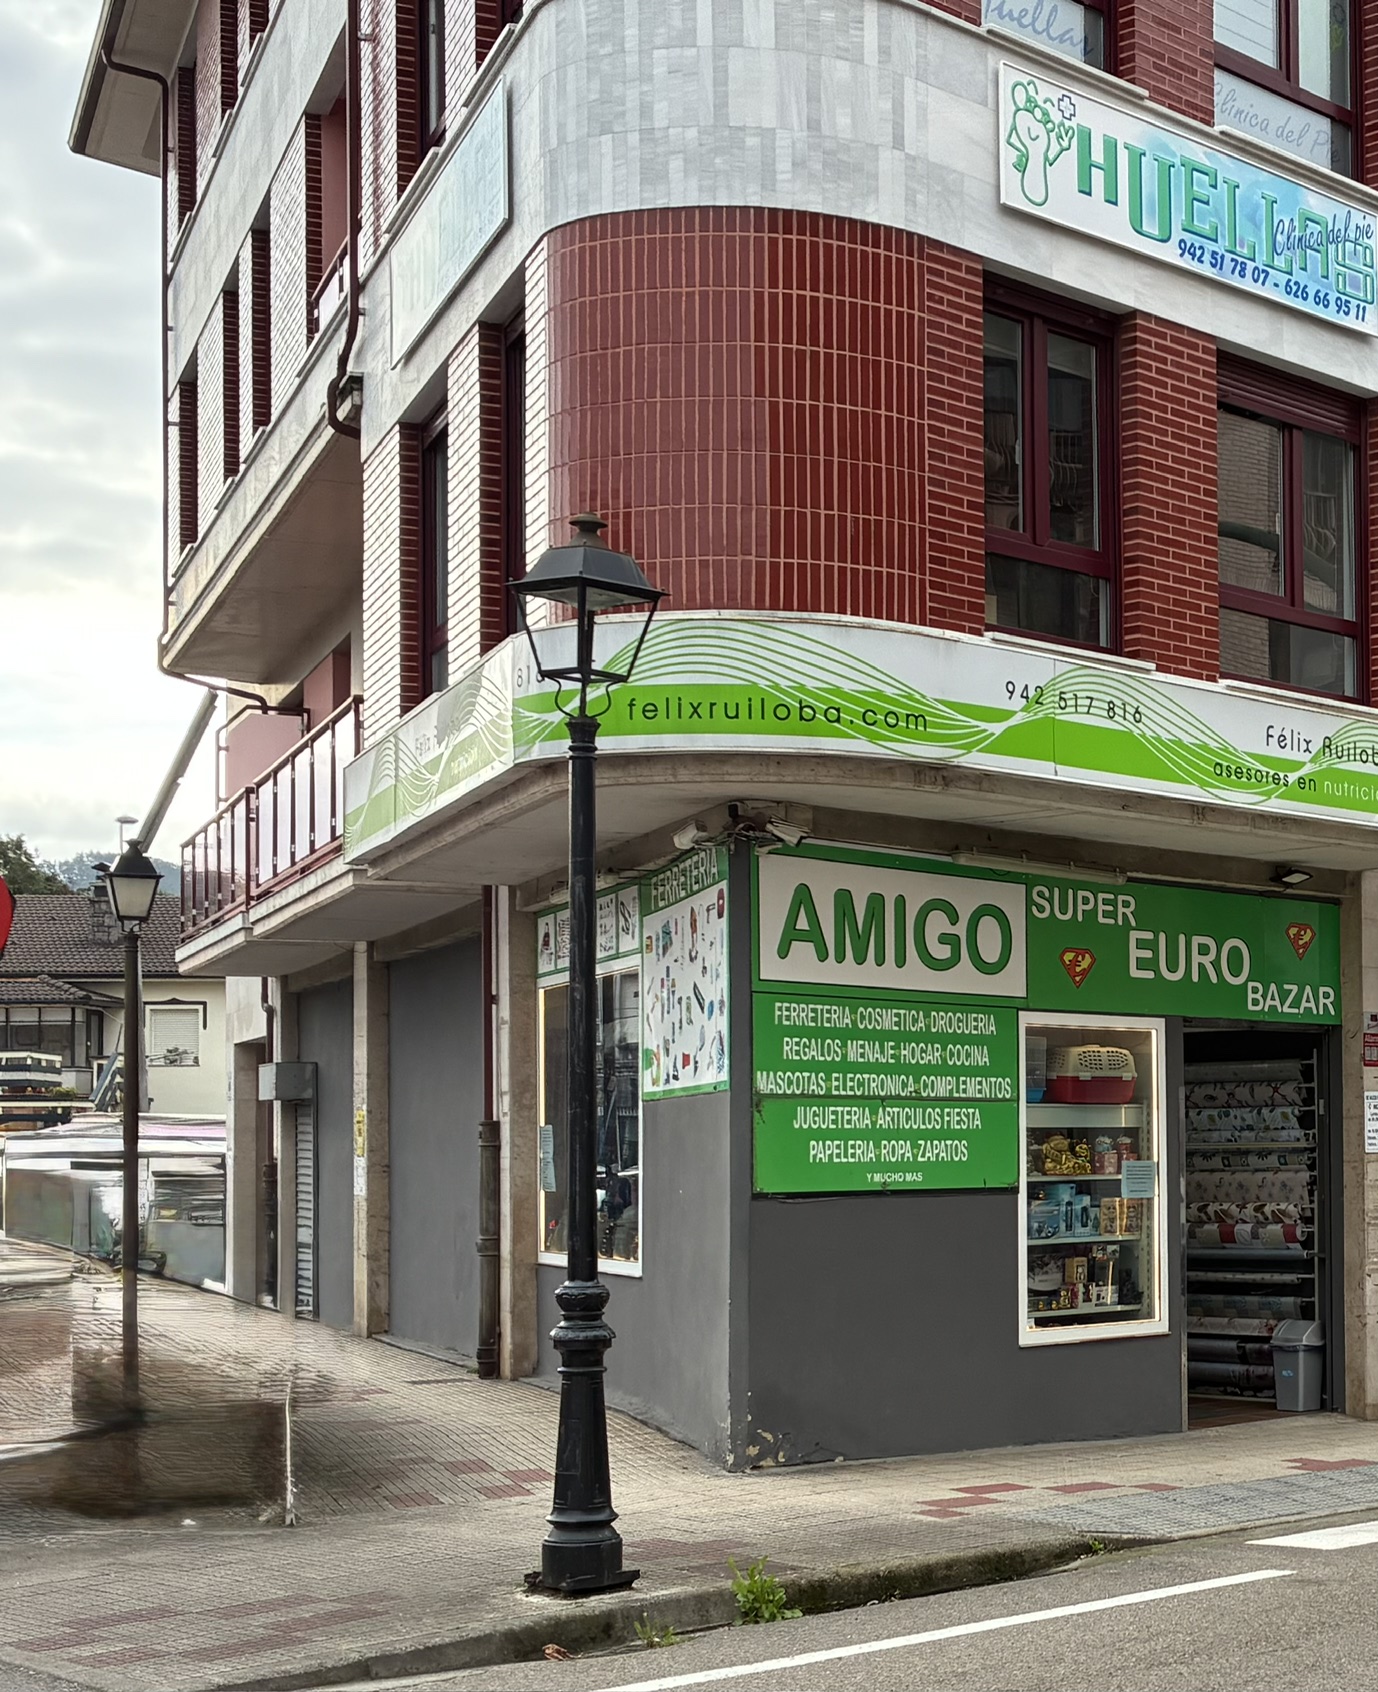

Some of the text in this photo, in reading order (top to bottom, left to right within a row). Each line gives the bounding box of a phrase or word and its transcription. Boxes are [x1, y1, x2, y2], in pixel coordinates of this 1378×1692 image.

[1276, 116, 1311, 147] del
[1077, 123, 1375, 304] HUELLAS
[1327, 210, 1352, 246] del
[1354, 215, 1374, 256] pie
[1178, 238, 1205, 264] 942
[1209, 251, 1225, 271] 51
[1230, 257, 1247, 279] 78
[1251, 267, 1270, 287] 07
[1284, 278, 1309, 301] 626
[1313, 289, 1330, 309] 66
[1334, 296, 1351, 317] 95
[1355, 303, 1367, 322] 11
[628, 696, 928, 732] felixruiloba.com
[1005, 681, 1143, 725] 942 517 816
[1266, 725, 1313, 756] Félix
[1213, 760, 1290, 789] asesores
[1297, 774, 1318, 792] en
[651, 848, 718, 910] FERRETERIA
[1031, 884, 1136, 928] SUPER
[777, 882, 1012, 976] AMIGO
[1128, 929, 1251, 985] EURO
[1247, 981, 1335, 1017] BAZAR
[775, 1002, 996, 1035] FERRETERIA COSMETICA DROGUERIA
[783, 1037, 989, 1066] REGALOS MENAJE HOGAR COCINA
[757, 1071, 1011, 1098] MASCOTAS ELECTRONICA COMPLEMENTOS
[794, 1106, 981, 1130] JUGUETERIA ARTICULOS FIESTA
[809, 1140, 968, 1163] PAPELERIA ROPA ZAPATOS
[866, 1172, 923, 1182] Y MUCHO MAS
